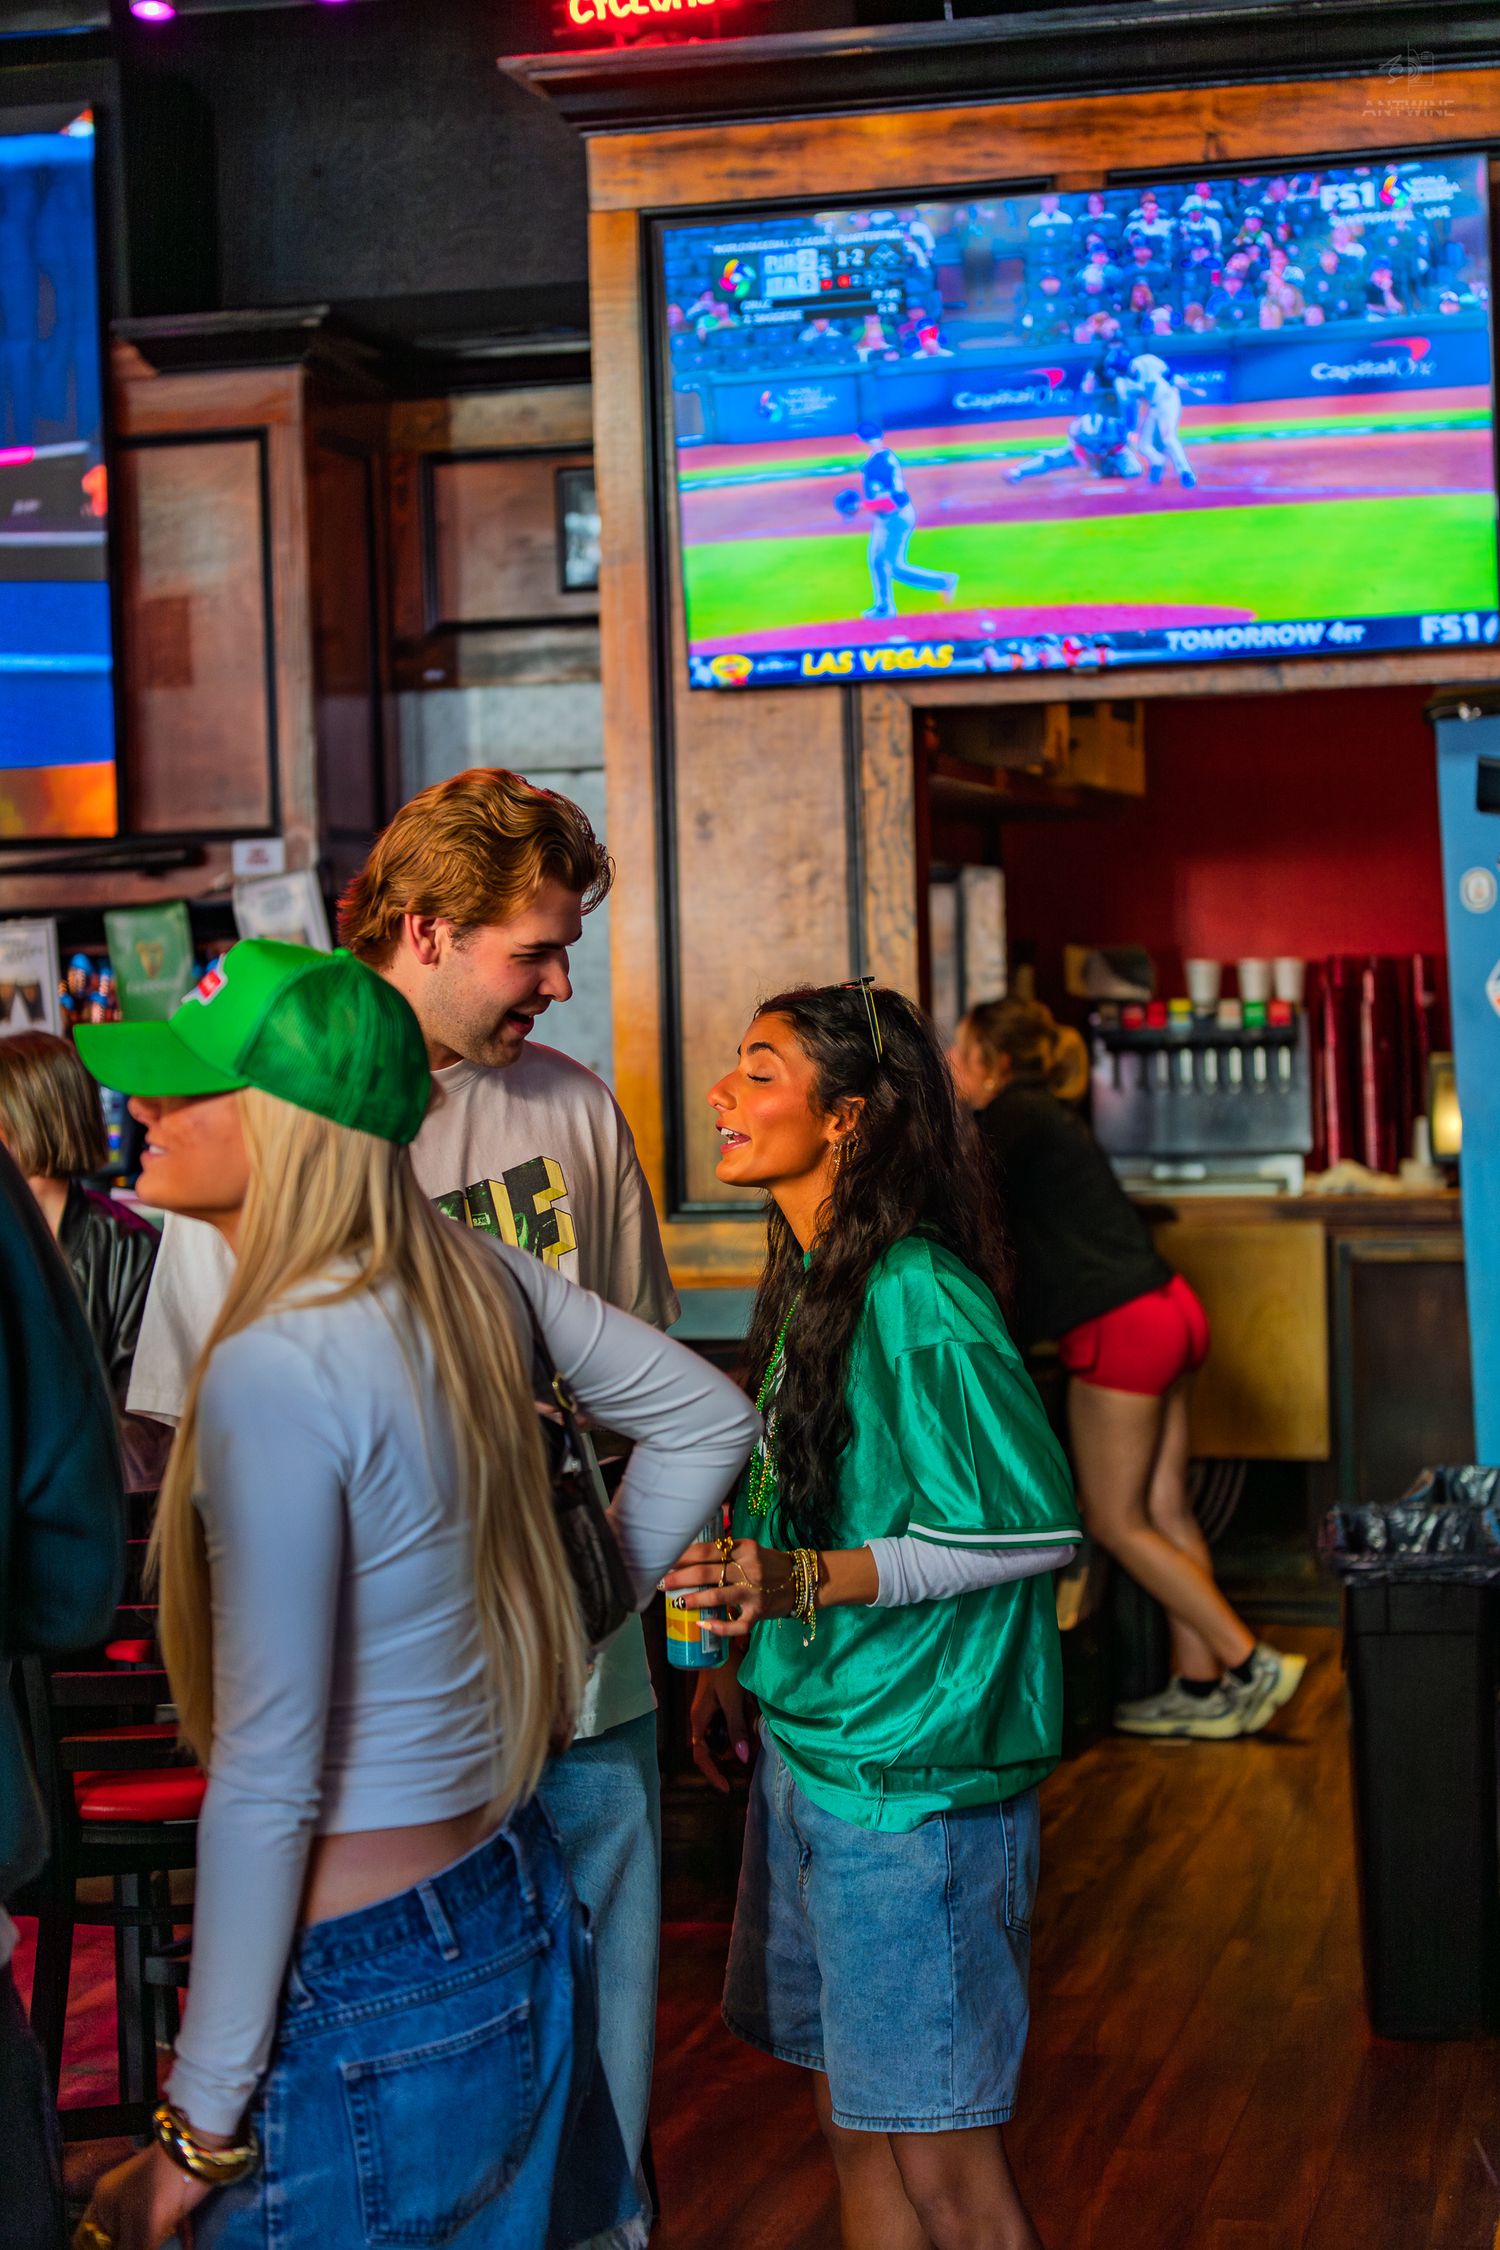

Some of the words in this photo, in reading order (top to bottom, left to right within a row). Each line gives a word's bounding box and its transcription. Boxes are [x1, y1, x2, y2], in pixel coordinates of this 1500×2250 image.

[1319, 181, 1376, 212] FS1
[1165, 621, 1326, 652] TOMORROW
[802, 650, 855, 677] LAS
[861, 644, 955, 672] VEGAS
